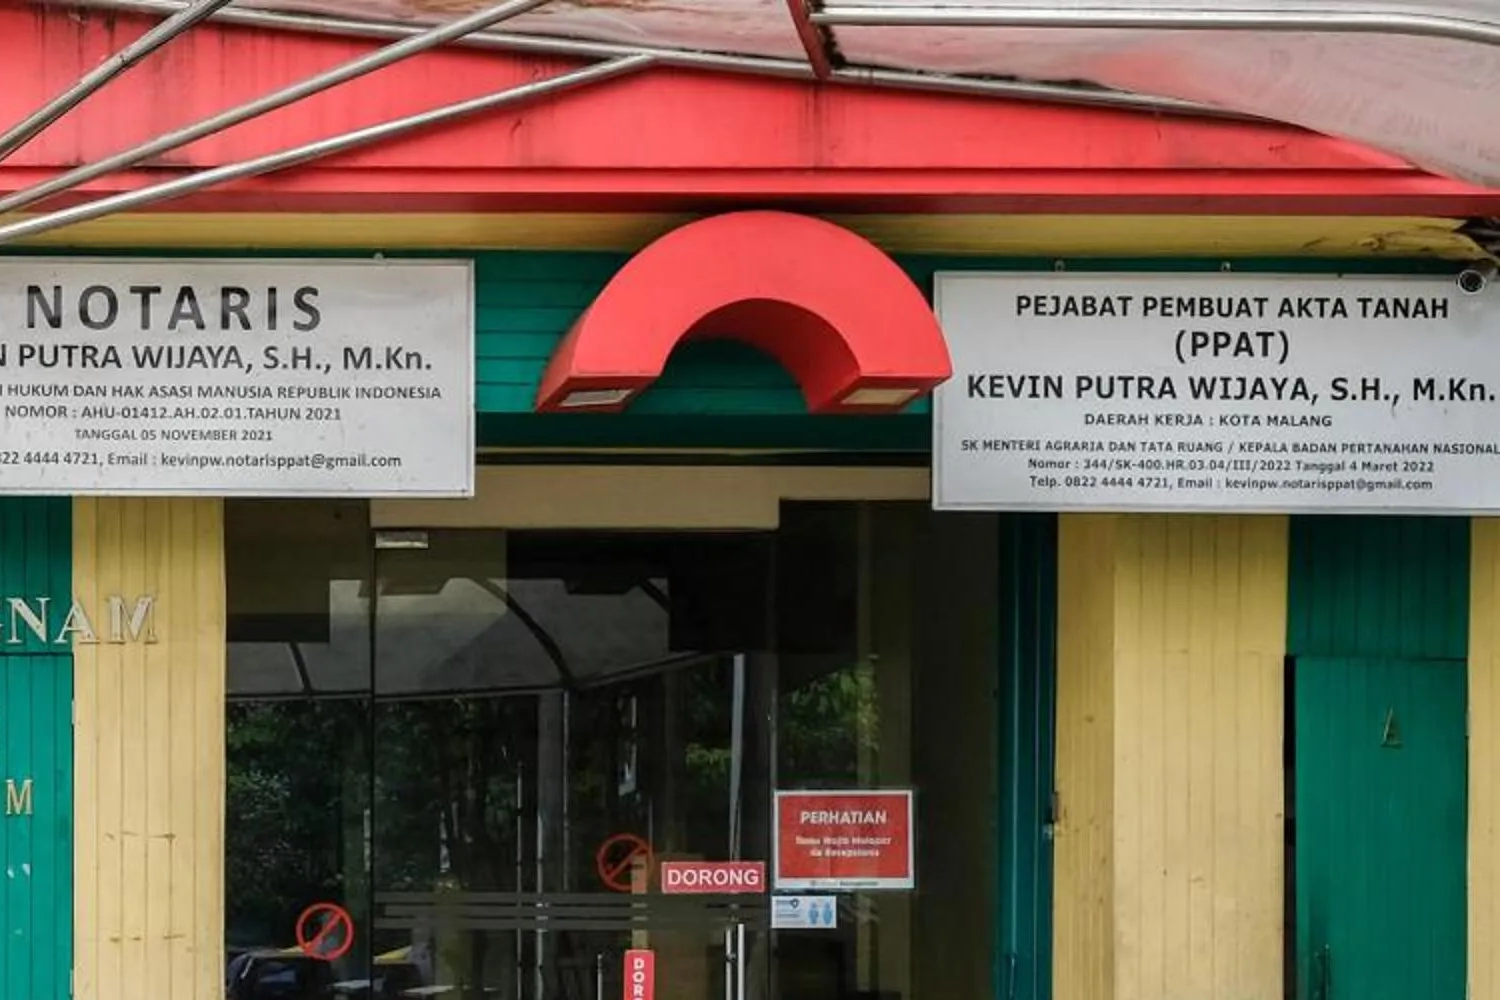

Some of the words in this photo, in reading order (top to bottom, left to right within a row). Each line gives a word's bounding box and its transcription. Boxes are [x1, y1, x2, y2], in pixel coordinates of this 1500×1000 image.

[26, 284, 321, 332] NOTARIS
[1016, 295, 1133, 317] PEJABAT
[1143, 296, 1269, 318] PEMBUAT
[1277, 297, 1349, 319] AKTA
[1356, 297, 1449, 319] TANAH
[1175, 329, 1289, 365] (PPAT)
[18, 343, 123, 369] PUTRA
[131, 345, 253, 374] WIJAYA,
[263, 345, 331, 375] S.H.,
[343, 346, 432, 370] M.Kn.
[7, 384, 69, 397] HUKUM
[73, 384, 107, 398] DAN
[111, 385, 145, 398] HAK
[148, 385, 193, 399] ASASI
[197, 385, 273, 399] MANUSIA
[277, 385, 351, 399] REPUBLIK
[355, 386, 442, 399] INDONESIA
[967, 374, 1063, 399] KEVIN
[1076, 375, 1177, 400] PUTRA
[1188, 376, 1319, 406] WIJAYA,
[1330, 377, 1400, 406] S.H.,
[1413, 377, 1495, 402] M.Kn.
[4, 405, 68, 419] NOMOR
[305, 407, 341, 421] 2021
[1084, 413, 1149, 425] DAERAH
[1154, 413, 1203, 427] KERJA
[1219, 414, 1261, 427] KOTA
[1266, 415, 1333, 428] MALANG
[74, 428, 138, 441] TANGGAL
[140, 429, 157, 441] 05
[160, 429, 237, 441] NOVEMBER
[241, 429, 273, 442] 2021
[961, 439, 979, 452] SK
[982, 439, 1041, 452] MENTERI
[1045, 440, 1105, 452] AGRARIA
[1108, 441, 1136, 453] DAN
[1140, 441, 1173, 452] TATA
[1177, 441, 1223, 453] RUANG
[1239, 441, 1289, 453] KEPALA
[1291, 442, 1337, 454] BADAN
[1341, 442, 1429, 455] PERTANAHAN
[1433, 442, 1500, 455] NASIONAL
[23, 451, 59, 465] 4444
[63, 451, 104, 467] 4721,
[107, 452, 148, 466] Email
[1027, 457, 1071, 469] Nomor
[1296, 460, 1346, 474] Tanggal
[1350, 461, 1358, 472] 4
[1361, 460, 1398, 473] Maret
[1402, 460, 1435, 473] 2022
[1029, 475, 1062, 489] Telp.
[1064, 475, 1097, 488] 0822
[1101, 476, 1133, 488] 4444
[1137, 477, 1173, 490] 4721,
[1177, 477, 1213, 489] Email
[800, 810, 888, 825] PERHATIAN
[667, 869, 760, 886] DORONG
